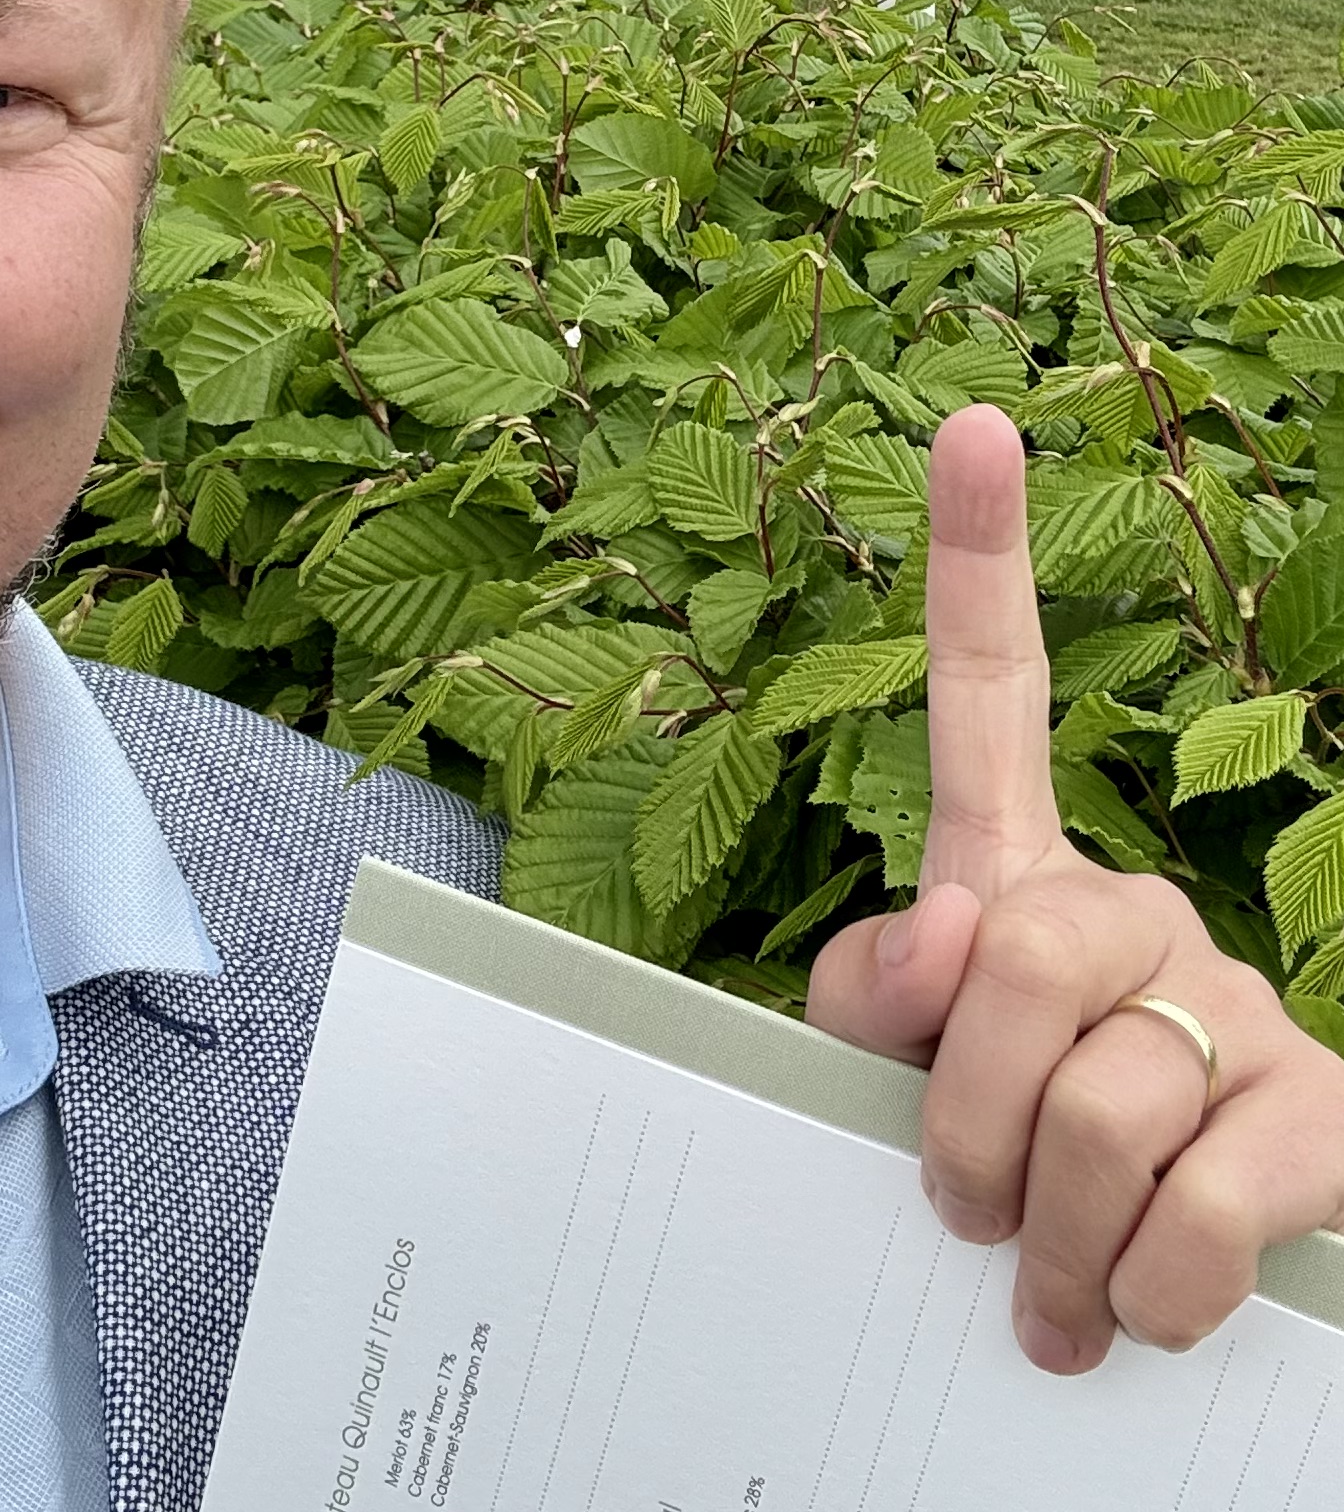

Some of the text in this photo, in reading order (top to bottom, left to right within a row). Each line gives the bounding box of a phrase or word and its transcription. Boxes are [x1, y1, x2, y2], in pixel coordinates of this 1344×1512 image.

[341, 1339, 389, 1450] Quinault
[384, 1408, 417, 1488] Merlot 63%
[407, 1352, 458, 1498] Cabernet franc 17%
[430, 1322, 492, 1508] Cabernet-Sauvignon 20%
[743, 1475, 766, 1508] 28%
